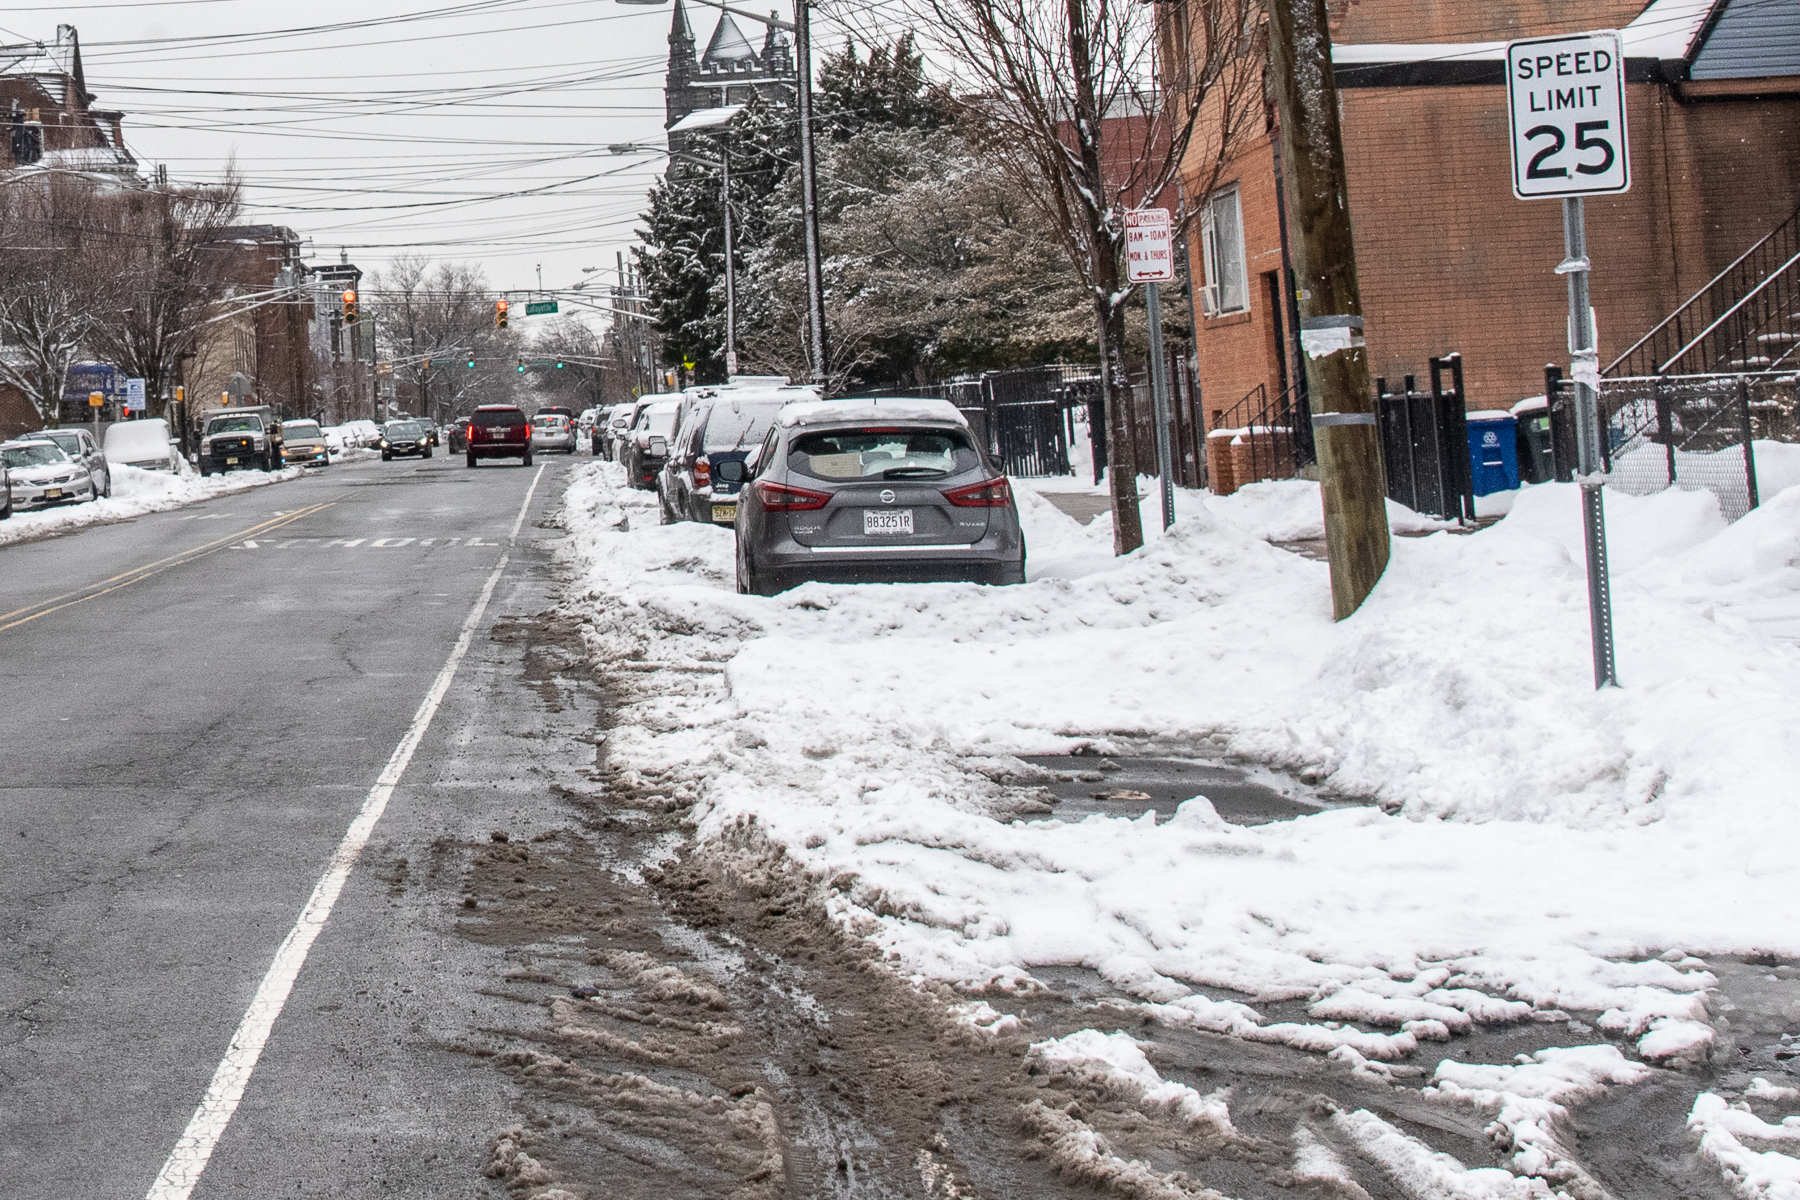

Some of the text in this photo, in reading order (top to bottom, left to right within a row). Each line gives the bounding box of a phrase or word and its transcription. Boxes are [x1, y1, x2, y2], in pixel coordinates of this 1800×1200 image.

[1517, 50, 1612, 80] SPEED
[1529, 85, 1602, 113] LIMIT
[1523, 119, 1616, 180] 25
[1126, 213, 1167, 226] NO PARKING
[1128, 231, 1143, 242] 8AM
[1150, 230, 1167, 241] 10AM
[1144, 251, 1149, 261] &
[866, 516, 910, 528] 883251R
